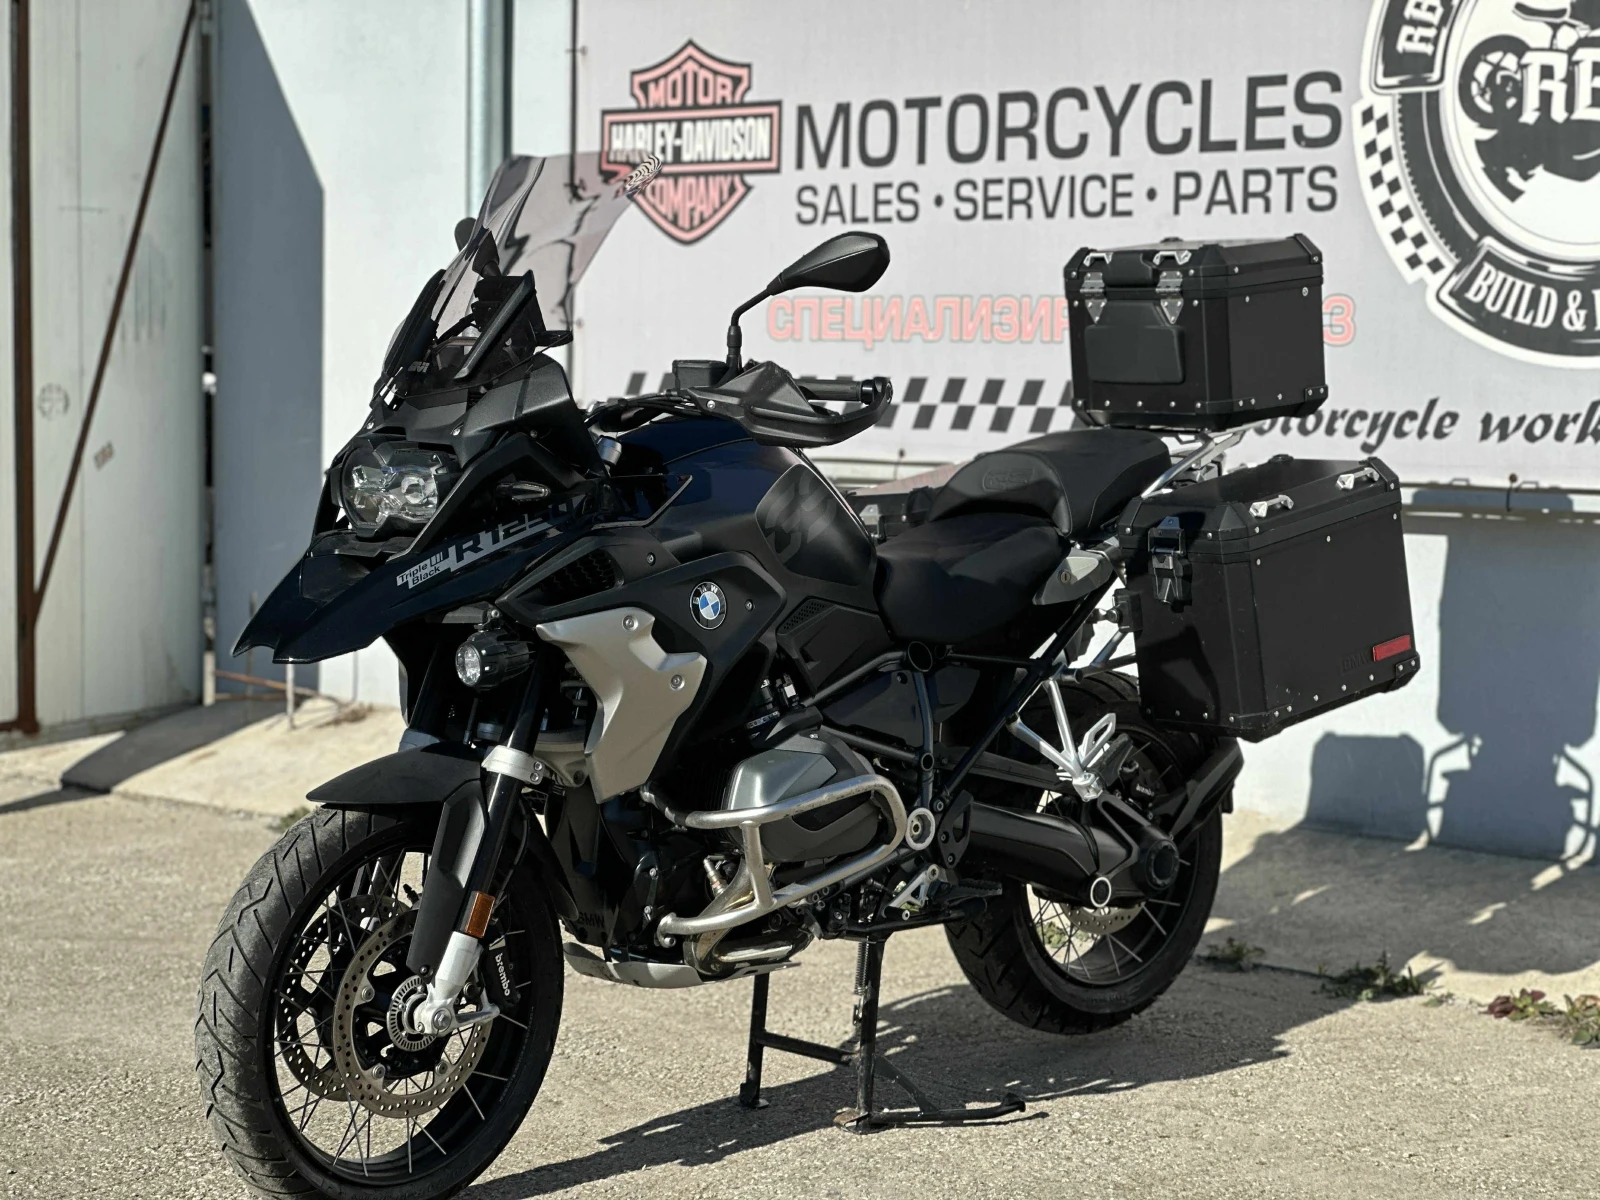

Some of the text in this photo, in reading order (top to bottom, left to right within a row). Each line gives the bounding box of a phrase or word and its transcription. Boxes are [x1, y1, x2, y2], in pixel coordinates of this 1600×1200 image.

[648, 60, 732, 108] MOTOR
[608, 117, 772, 163] HARLEY-DAVIDSON
[796, 71, 1342, 170] MOTORCYCLES
[646, 174, 732, 230] COMPANY
[797, 165, 1337, 225] SALES SERVICE PARTS
[1465, 261, 1558, 329] BUILD
[1562, 289, 1588, 332] &
[400, 562, 428, 583] Triple
[412, 565, 441, 585] Black
[494, 952, 511, 997] brembo
